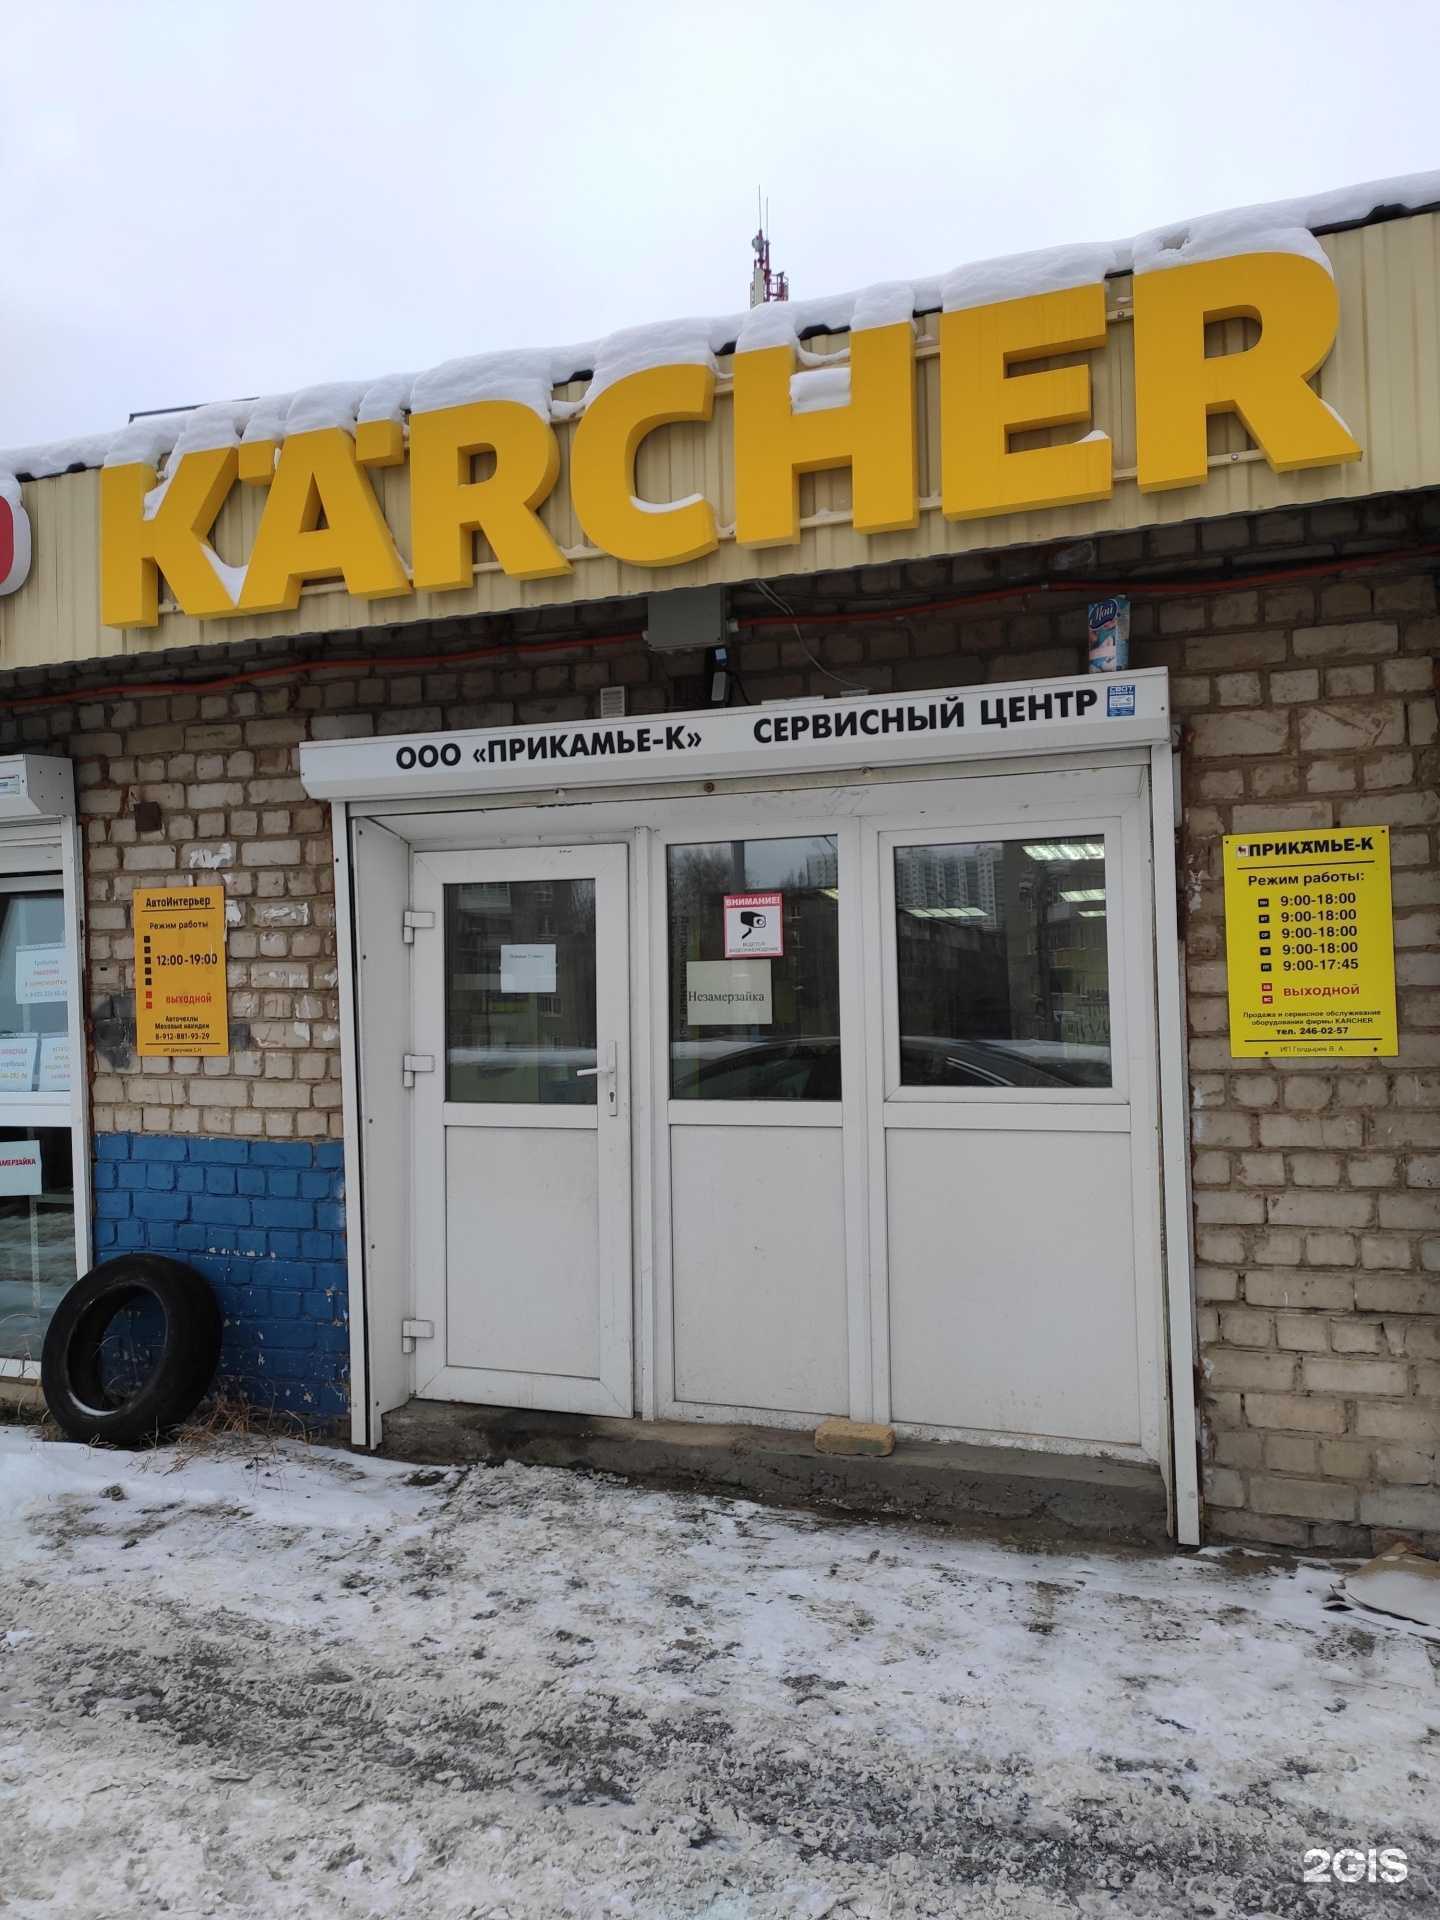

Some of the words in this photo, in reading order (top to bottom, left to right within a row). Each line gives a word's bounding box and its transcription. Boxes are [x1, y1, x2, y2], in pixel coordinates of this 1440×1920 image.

[101, 251, 1362, 630] KÄRCHER
[753, 696, 965, 744] СЕРВИСНЫЙ
[980, 688, 1098, 729] ЦЕНТР
[395, 743, 462, 770] ООО
[472, 725, 702, 764] «ПРИКАМЬЕ-К»
[1248, 875, 1299, 887] Режим
[1303, 872, 1365, 887] работы:
[145, 896, 211, 908] АвтоИнтерьер
[725, 896, 781, 906] ВНИМАНИЕ!
[1280, 892, 1356, 906] 9:00-18:00
[1281, 909, 1357, 923] 9:00-18:00
[149, 922, 177, 930] Режим
[178, 921, 209, 931] работы
[1281, 925, 1358, 939] 9:00-18:00
[1282, 942, 1358, 955] 9:00-18:00
[1283, 958, 1359, 971] 9:00-17:45
[687, 991, 765, 1005] Незамерзайка
[1283, 984, 1360, 998] ВЫХОДНОЙ
[1326, 1009, 1381, 1018] обслуживание
[1305, 1019, 1334, 1027] фирмы
[1299, 1026, 1349, 1035] 246-02-57
